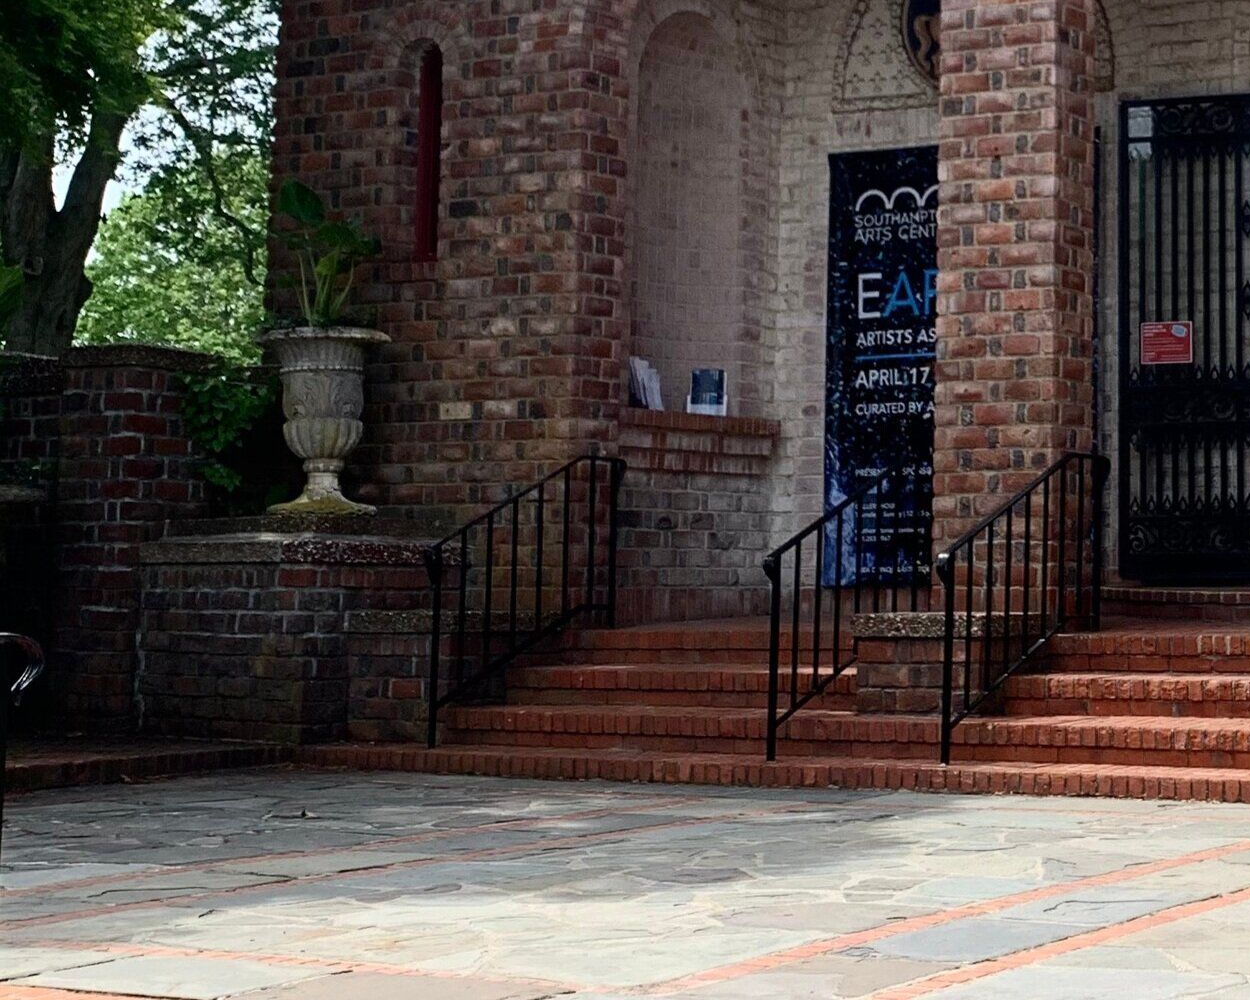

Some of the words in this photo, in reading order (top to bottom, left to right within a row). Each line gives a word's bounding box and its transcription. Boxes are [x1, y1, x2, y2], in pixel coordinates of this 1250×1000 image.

[854, 209, 937, 228] SOUTHAMPT
[854, 227, 893, 242] ARTS
[898, 223, 937, 240] CENT
[856, 330, 913, 347] ARTISTS
[855, 369, 904, 389] APRIL
[910, 367, 930, 385] 17
[855, 403, 905, 416] CURATED
[908, 402, 924, 414] BY
